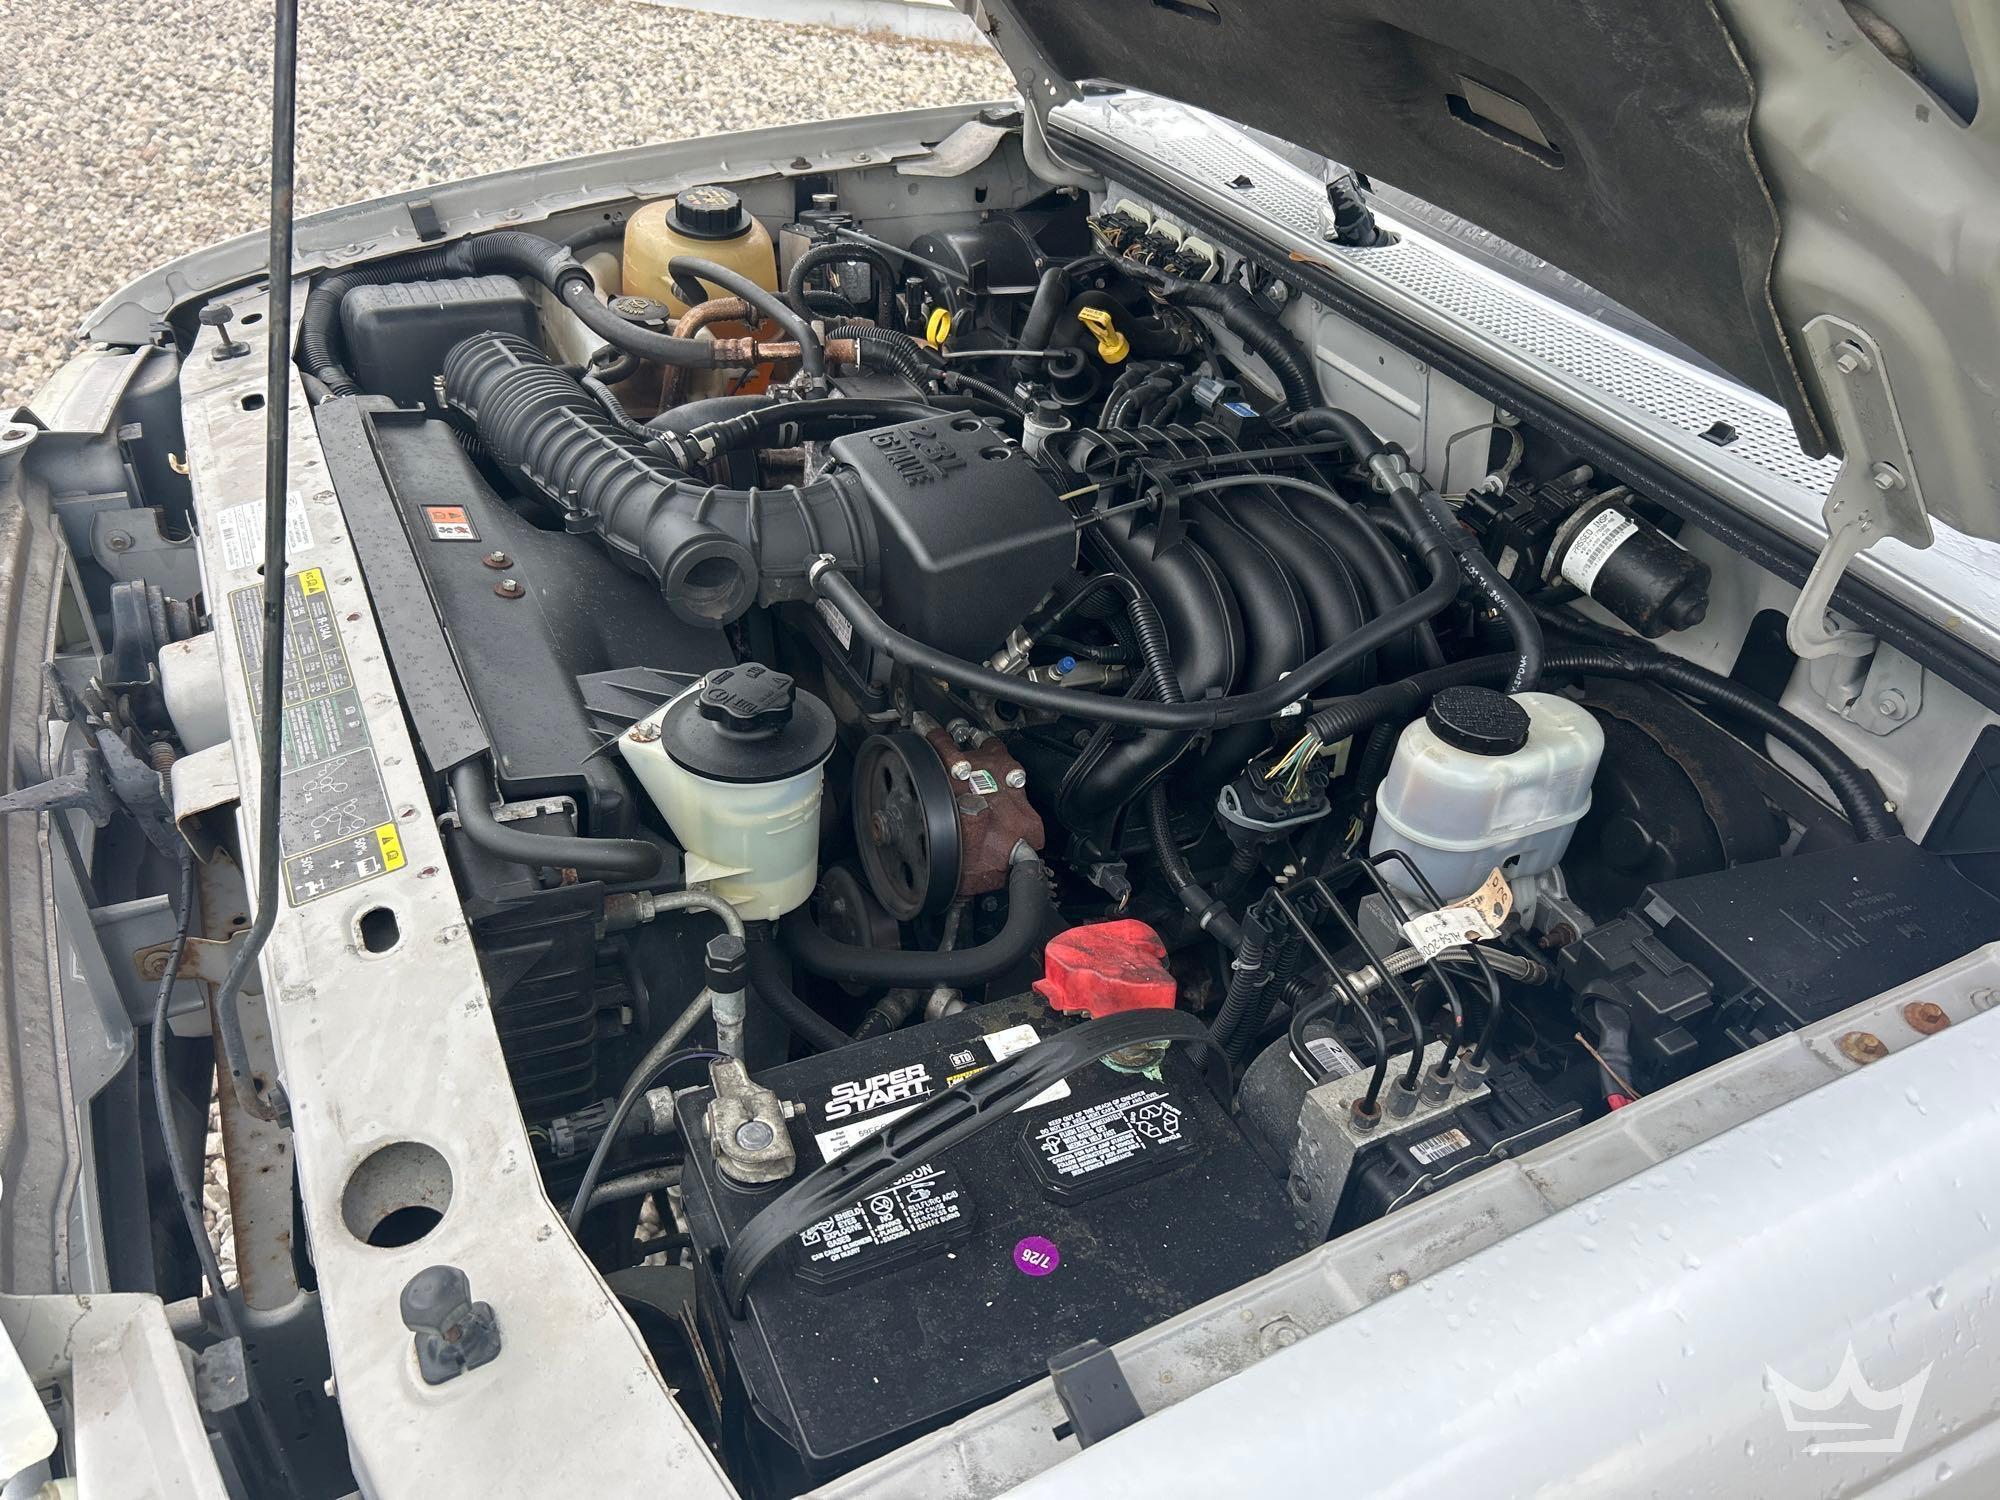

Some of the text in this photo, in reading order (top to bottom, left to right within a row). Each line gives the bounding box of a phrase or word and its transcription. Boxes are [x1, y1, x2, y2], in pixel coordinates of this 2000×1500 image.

[908, 426, 967, 478] 2.3L
[1572, 528, 1593, 554] PASSED
[1593, 513, 1608, 528] INSP
[317, 616, 333, 641] R-134A
[354, 837, 368, 856] 50%
[301, 856, 315, 875] 50%
[952, 1052, 973, 1065] STD
[1331, 1045, 1342, 1054] 2
[831, 1063, 926, 1103] SUPER
[824, 1075, 931, 1122] START
[1049, 1118, 1061, 1126] KEEP
[1063, 1114, 1074, 1122] OUT
[1083, 1107, 1095, 1117] THE
[1095, 1101, 1111, 1113] REACH
[1121, 1091, 1145, 1103] CHILDREN
[1073, 1117, 1086, 1125] KEEP
[1088, 1111, 1101, 1120] VENT
[1132, 1097, 1143, 1105] AND
[1059, 1112, 1123, 1138] FLUSH EYES IMMEDIATELY
[1062, 1134, 1076, 1143] WITH
[1096, 1125, 1106, 1133] GET
[1066, 1129, 1117, 1150] MEDICAL HELP FAST
[1057, 1158, 1077, 1168] FOLLOW
[908, 1190, 958, 1213] SULFURIC ACID
[925, 1204, 946, 1214] CAUSE
[834, 1207, 861, 1221] SHIELD
[838, 1216, 858, 1229] EYES
[879, 1214, 894, 1223] NO
[824, 1222, 863, 1241] EXPLOSIVE
[826, 1234, 852, 1248] GASES
[1021, 1249, 1050, 1269] 7/26
